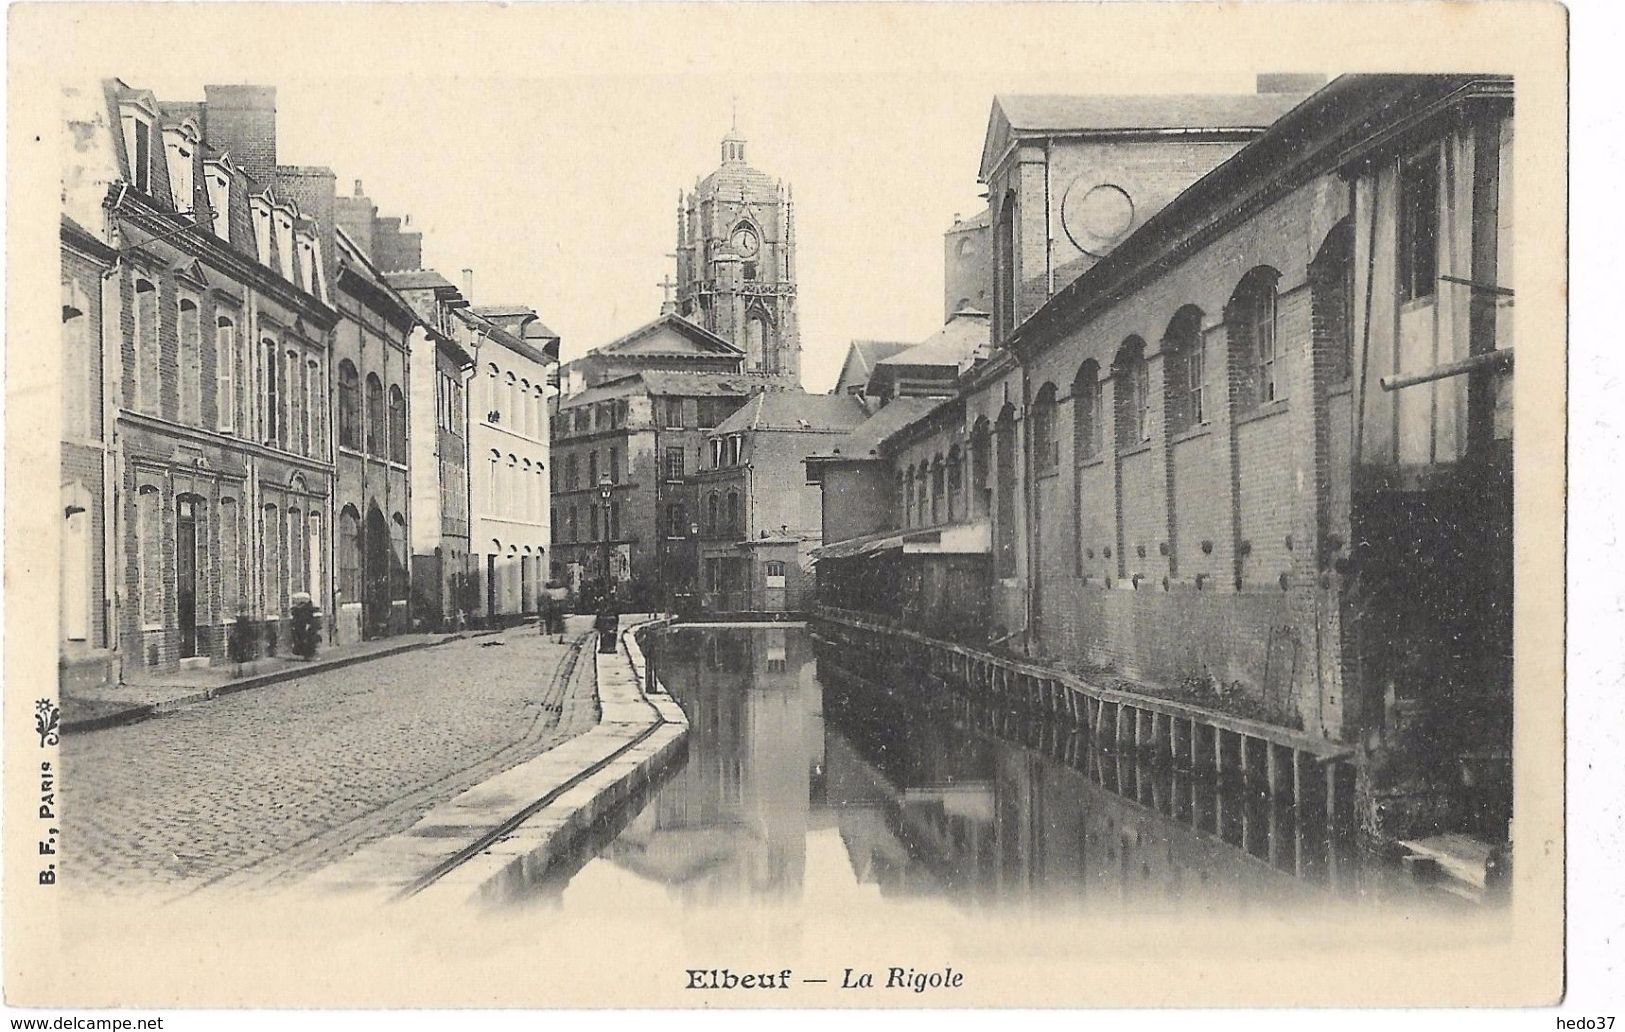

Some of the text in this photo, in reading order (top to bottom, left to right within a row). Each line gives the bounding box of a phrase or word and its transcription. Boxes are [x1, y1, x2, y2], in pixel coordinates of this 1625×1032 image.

[39, 761, 60, 885] B. F., PARIS
[685, 968, 792, 989] Elbeuf
[841, 968, 873, 989] La
[885, 967, 964, 993] Rigole
